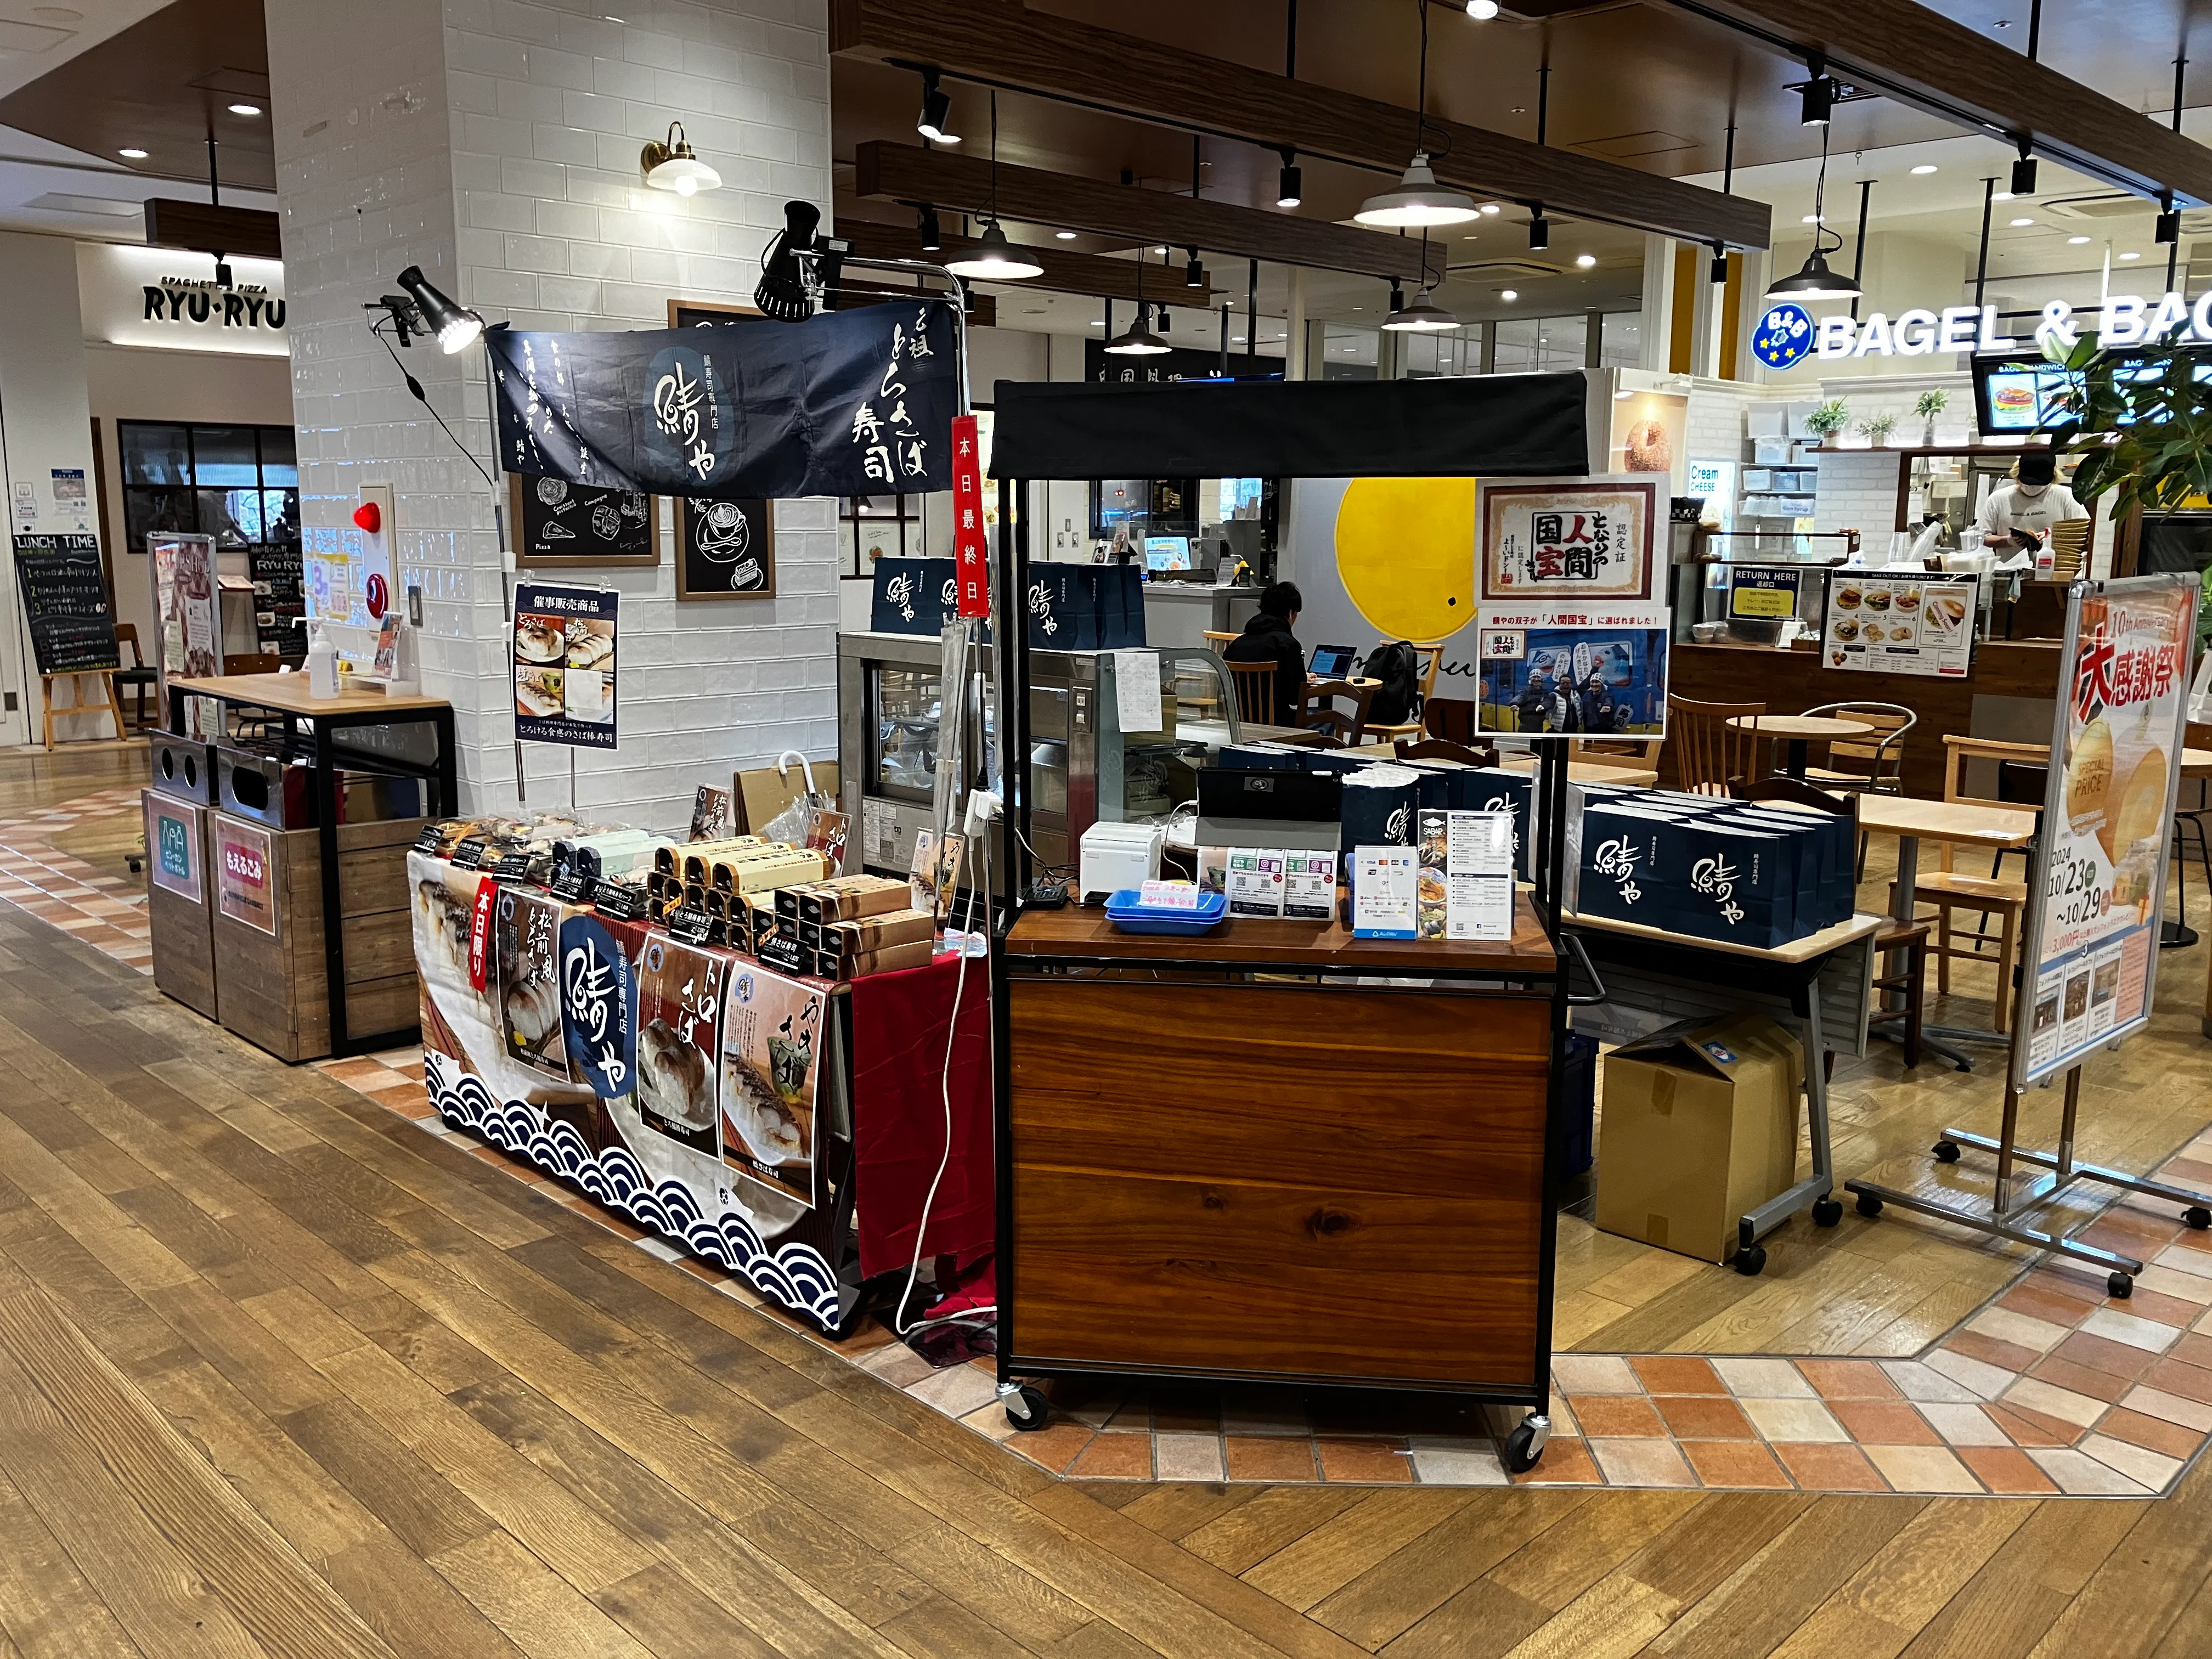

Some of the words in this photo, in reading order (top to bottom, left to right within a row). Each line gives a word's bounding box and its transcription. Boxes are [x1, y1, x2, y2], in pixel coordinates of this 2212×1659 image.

[238, 284, 268, 294] PIZZA
[1768, 311, 1808, 338] B&B
[1818, 303, 2015, 360] BAGEL
[2035, 300, 2080, 346] &
[654, 362, 715, 481] 鯖や
[852, 402, 894, 483] 寿司
[1690, 482, 1715, 492] CHEESE
[1691, 465, 1718, 480] Cream
[15, 536, 57, 549] LUNCH
[63, 535, 97, 548] TIME
[959, 437, 978, 600] 本日最終日
[1592, 515, 1610, 566] となりの
[1615, 523, 1628, 563] 認定証
[1535, 514, 1565, 577] 国宝
[1562, 515, 1594, 579] 人間
[30, 585, 37, 597] 2
[886, 572, 915, 623] 鯖や
[1736, 571, 1770, 579] RETURN
[1774, 572, 1797, 581] HERE
[35, 603, 41, 615] 3
[534, 595, 600, 613] 催事販売商品
[1029, 580, 1058, 636] 鯖や
[2078, 624, 2175, 723] 大感謝祭
[2075, 774, 2102, 798] PRICE
[2078, 759, 2105, 773] SPECIAL
[1593, 834, 1643, 905] 鯖や
[2048, 859, 2085, 898] 10/23
[2051, 847, 2071, 868] 2024
[1690, 853, 1745, 925] 鯖や
[472, 893, 490, 977] 本日限り
[535, 908, 556, 984] 松前風
[771, 936, 797, 953] 焼さば寿司
[566, 937, 627, 1092] 鯖や
[678, 978, 699, 1049] さば
[697, 960, 716, 1023] トロ
